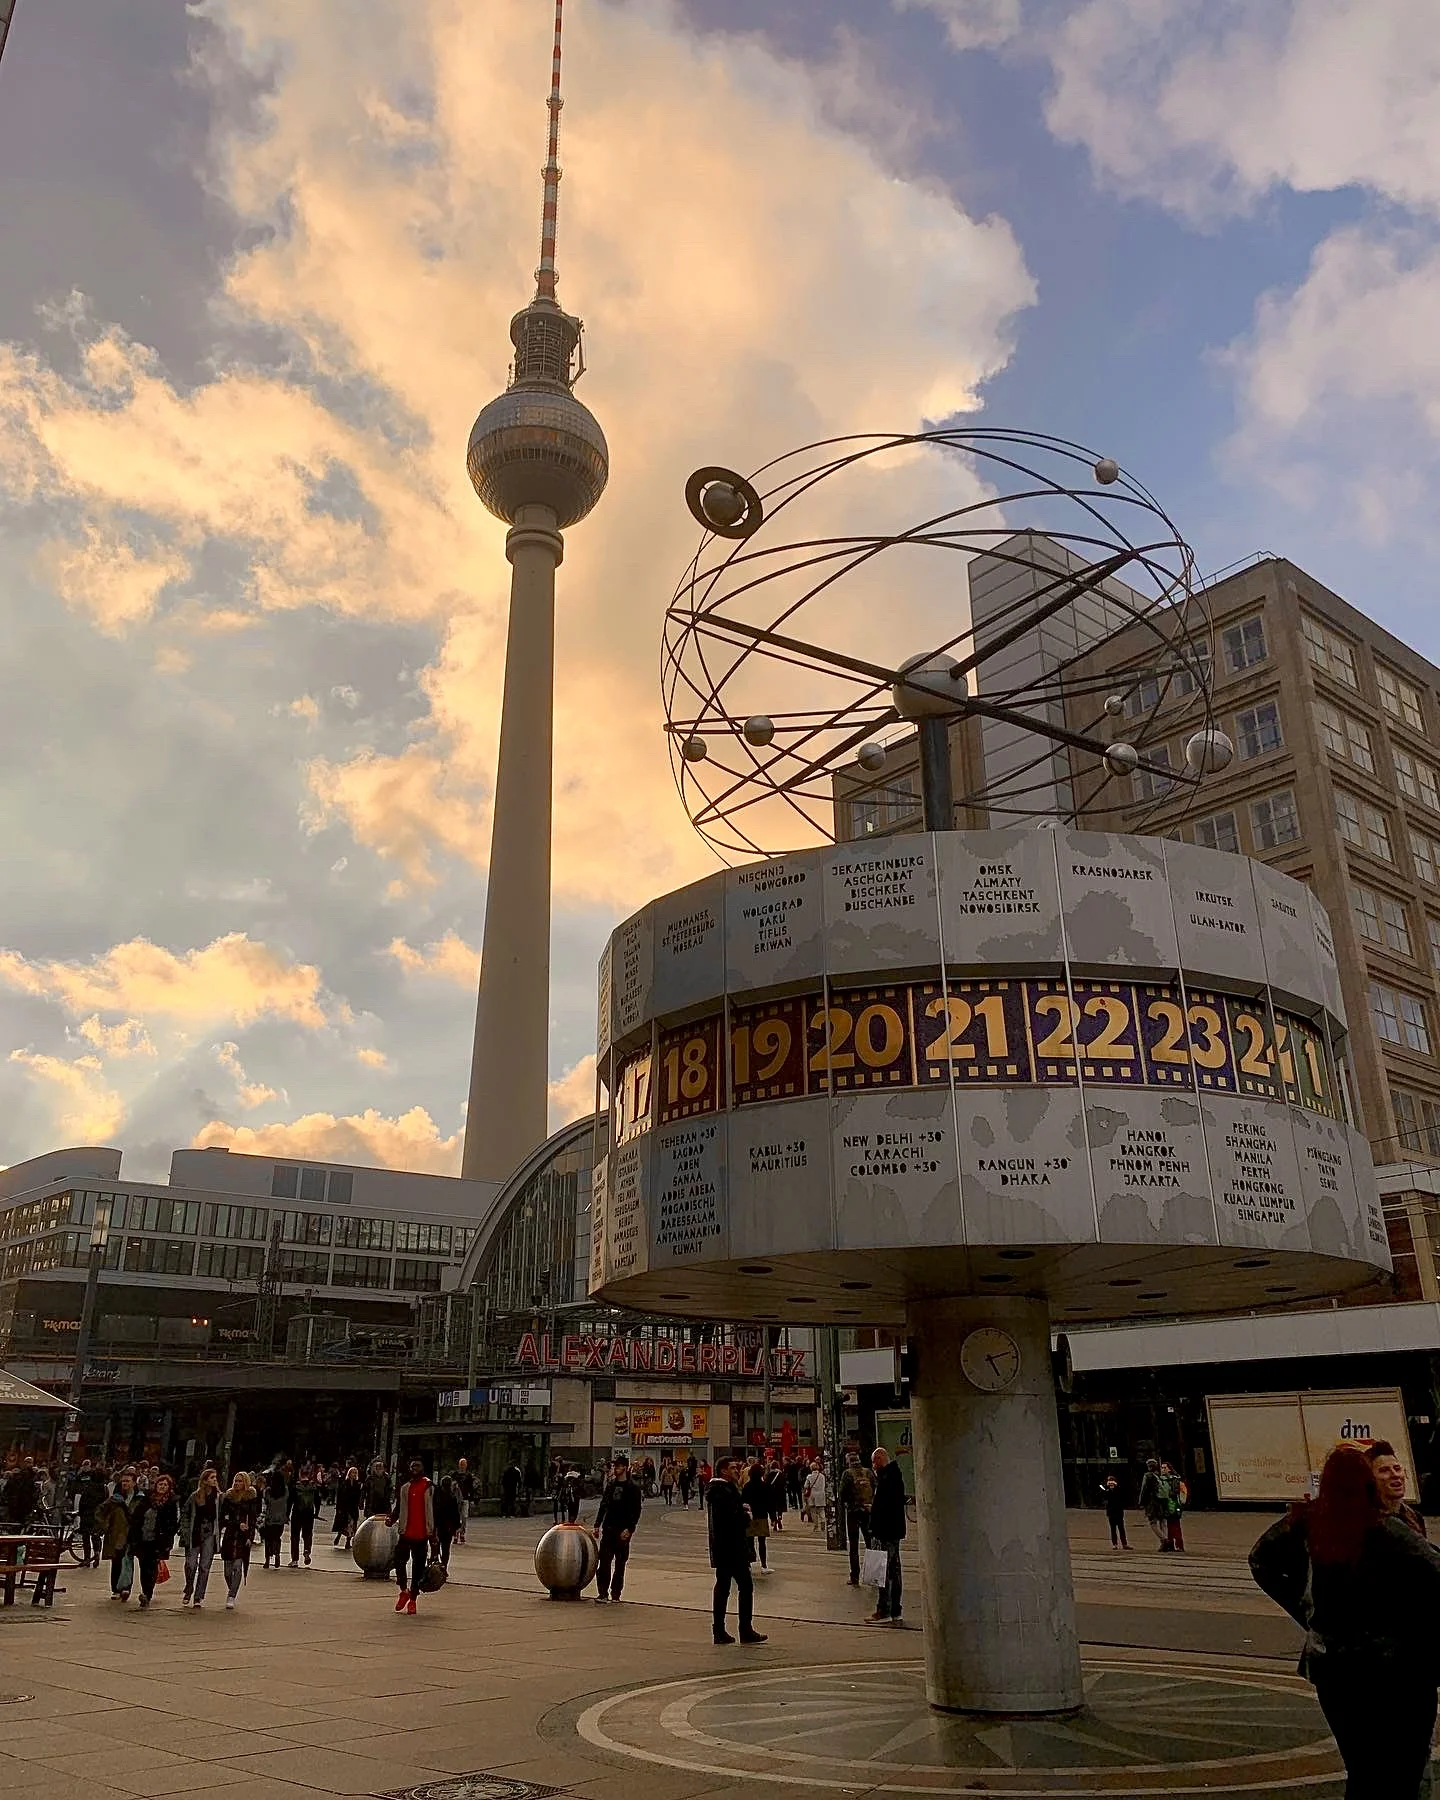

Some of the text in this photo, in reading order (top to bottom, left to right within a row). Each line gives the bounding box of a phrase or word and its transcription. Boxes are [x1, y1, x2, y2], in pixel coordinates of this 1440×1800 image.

[832, 856, 925, 876] JEKATERINBURG
[979, 864, 1013, 875] OMSK
[1071, 865, 1153, 881] KRASNOJARSK
[738, 865, 784, 885] NISCHNIJ
[754, 872, 806, 893] NOWGOROD
[844, 870, 914, 887] ASCHGABAT
[973, 877, 1022, 889] ALMATY
[851, 883, 907, 899] BISCHKEK
[963, 889, 1035, 902] TASCHKENT
[845, 895, 915, 912] DUSCHANBE
[1195, 891, 1234, 908] IRKUTSK
[743, 898, 803, 920] WOLGOGRAD
[960, 902, 1041, 915] NOWOSIBIRSK
[759, 913, 786, 928] BAKU
[1190, 914, 1247, 934] ULAN-BATOR
[758, 926, 787, 941] TIFLIS
[754, 937, 792, 954] ERIWAN
[925, 996, 1008, 1060] 21
[1035, 995, 1136, 1060] 22
[1147, 1001, 1227, 1069] 23
[809, 1004, 904, 1073] 20
[731, 1019, 792, 1086] 19
[1236, 1013, 1296, 1084] 24
[664, 1038, 709, 1105] 18
[1128, 1130, 1167, 1143] HANOI
[1233, 1122, 1266, 1137] PEKING
[660, 1132, 697, 1150] TEHERAN
[843, 1135, 869, 1148] NEW
[876, 1132, 913, 1146] DELHI
[1225, 1136, 1277, 1152] SHANGHAI
[672, 1144, 704, 1160] BAGDAD
[750, 1144, 783, 1160] KABUL
[864, 1147, 924, 1161] KARACHI
[1120, 1144, 1177, 1158] BANGKOK
[1234, 1151, 1273, 1166] MANILA
[677, 1159, 700, 1172] ADEN
[751, 1155, 808, 1173] MAURITIUS
[850, 1162, 907, 1176] COLOMBO
[978, 1158, 1035, 1171] RANGUN
[1110, 1159, 1190, 1173] PHNOM PENH
[672, 1174, 703, 1187] SANAA
[1001, 1173, 1051, 1186] DHAKA
[1123, 1174, 1181, 1188] JAKARTA
[1241, 1166, 1271, 1180] PERTH
[661, 1183, 715, 1203] ADDIS ABEBA
[1232, 1179, 1284, 1195] HONGKONG
[661, 1198, 715, 1216] MOGADISCHU
[1224, 1193, 1296, 1211] KUALA LUMPUR
[1238, 1208, 1286, 1224] SINGAPUR
[656, 1224, 721, 1245] ANTANANARIVO
[672, 1241, 703, 1256] KUWAIT
[516, 1332, 806, 1377] ALEXANDERPLATZ
[1340, 1418, 1371, 1439] dm
[1220, 1472, 1241, 1483] Duft
